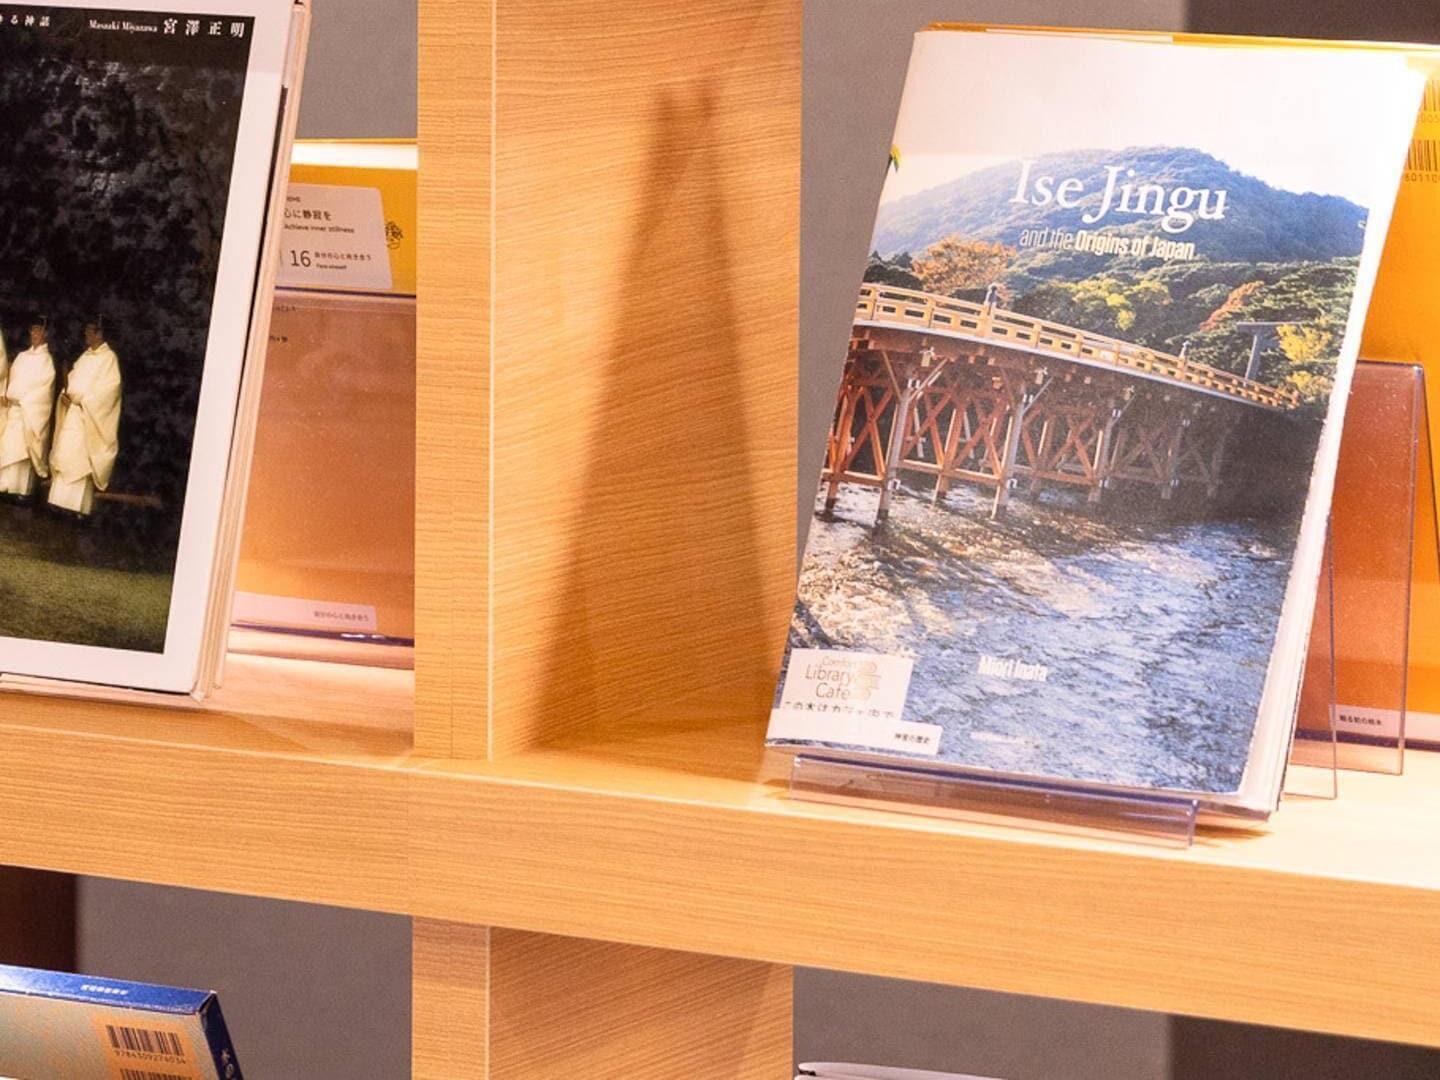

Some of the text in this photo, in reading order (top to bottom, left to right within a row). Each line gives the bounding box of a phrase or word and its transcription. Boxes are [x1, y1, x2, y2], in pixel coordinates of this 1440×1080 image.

[163, 17, 246, 38] 宮澤正明
[1009, 159, 1229, 234] Ise Jingu
[1019, 226, 1195, 262] and the Origins of Japan
[290, 249, 311, 268] 16
[805, 664, 854, 685] Library
